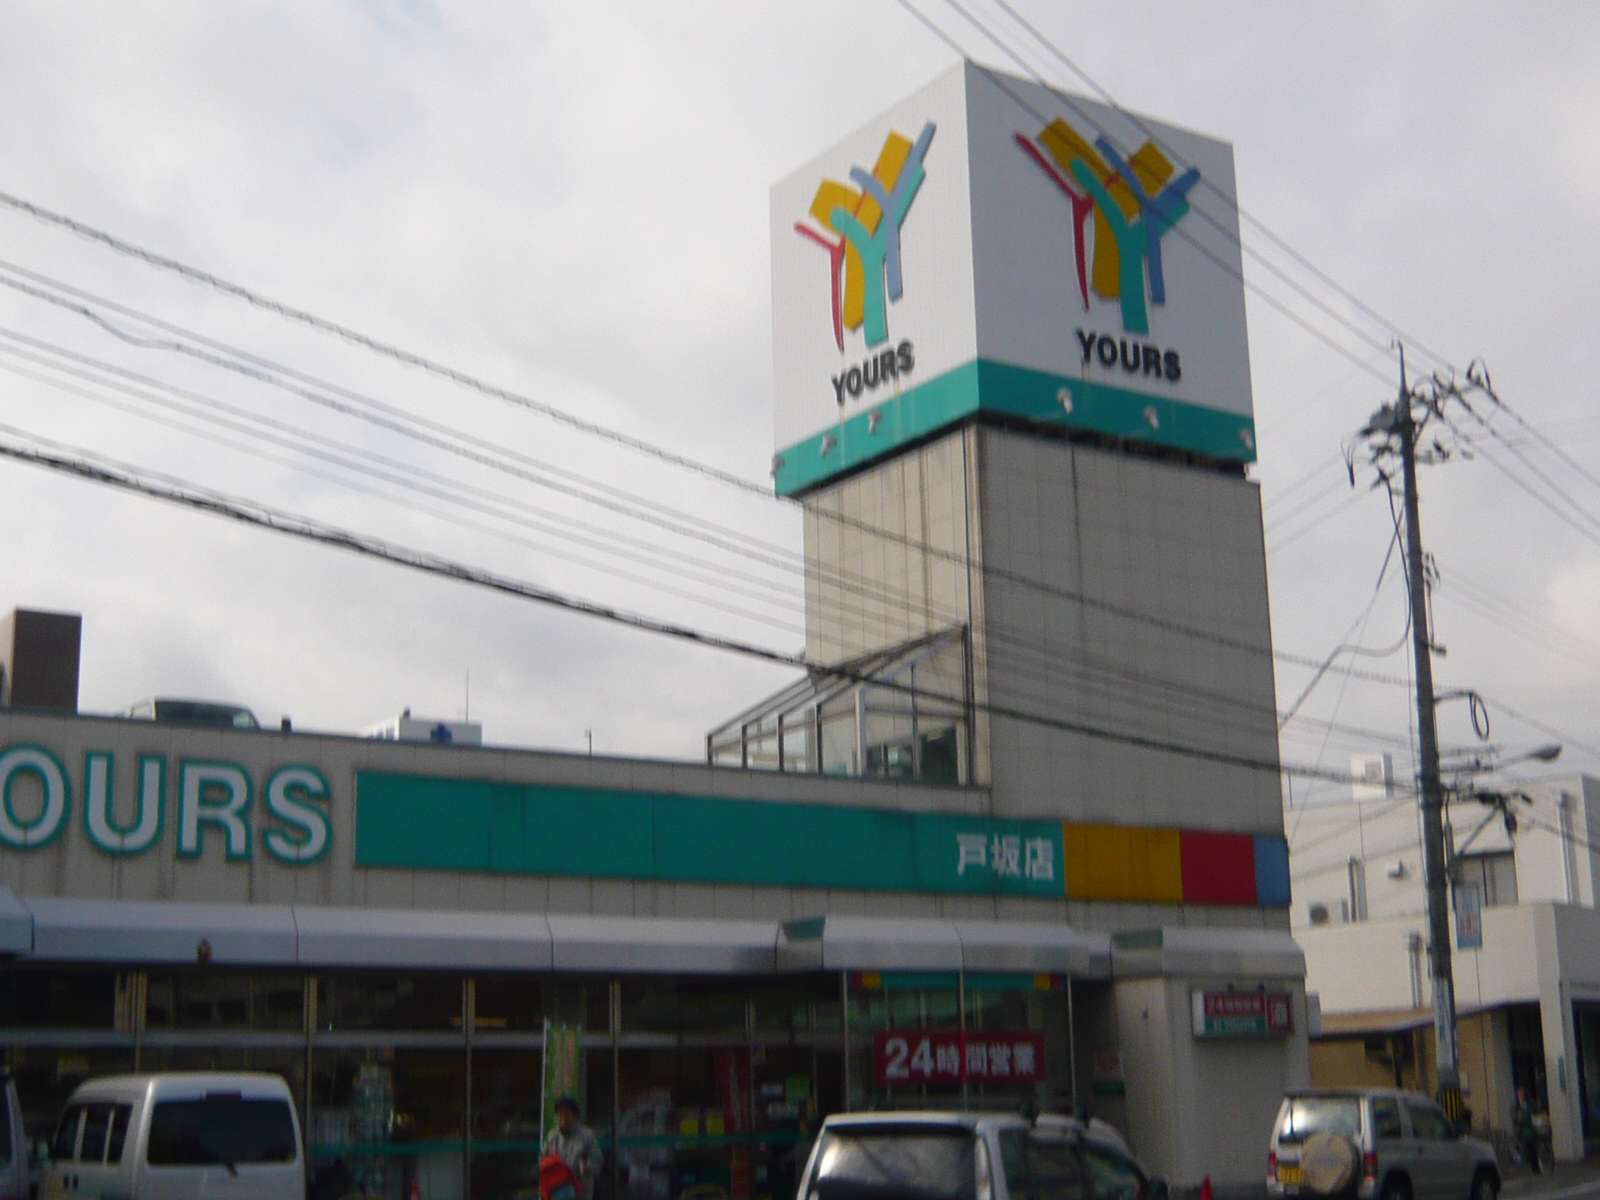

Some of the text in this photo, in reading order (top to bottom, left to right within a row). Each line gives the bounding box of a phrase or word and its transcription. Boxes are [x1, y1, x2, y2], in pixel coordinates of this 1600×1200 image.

[831, 339, 914, 406] YOURS
[1076, 327, 1182, 382] YOURS
[956, 832, 1054, 881] 戸坂店
[884, 1036, 1036, 1079] 24時間営業
